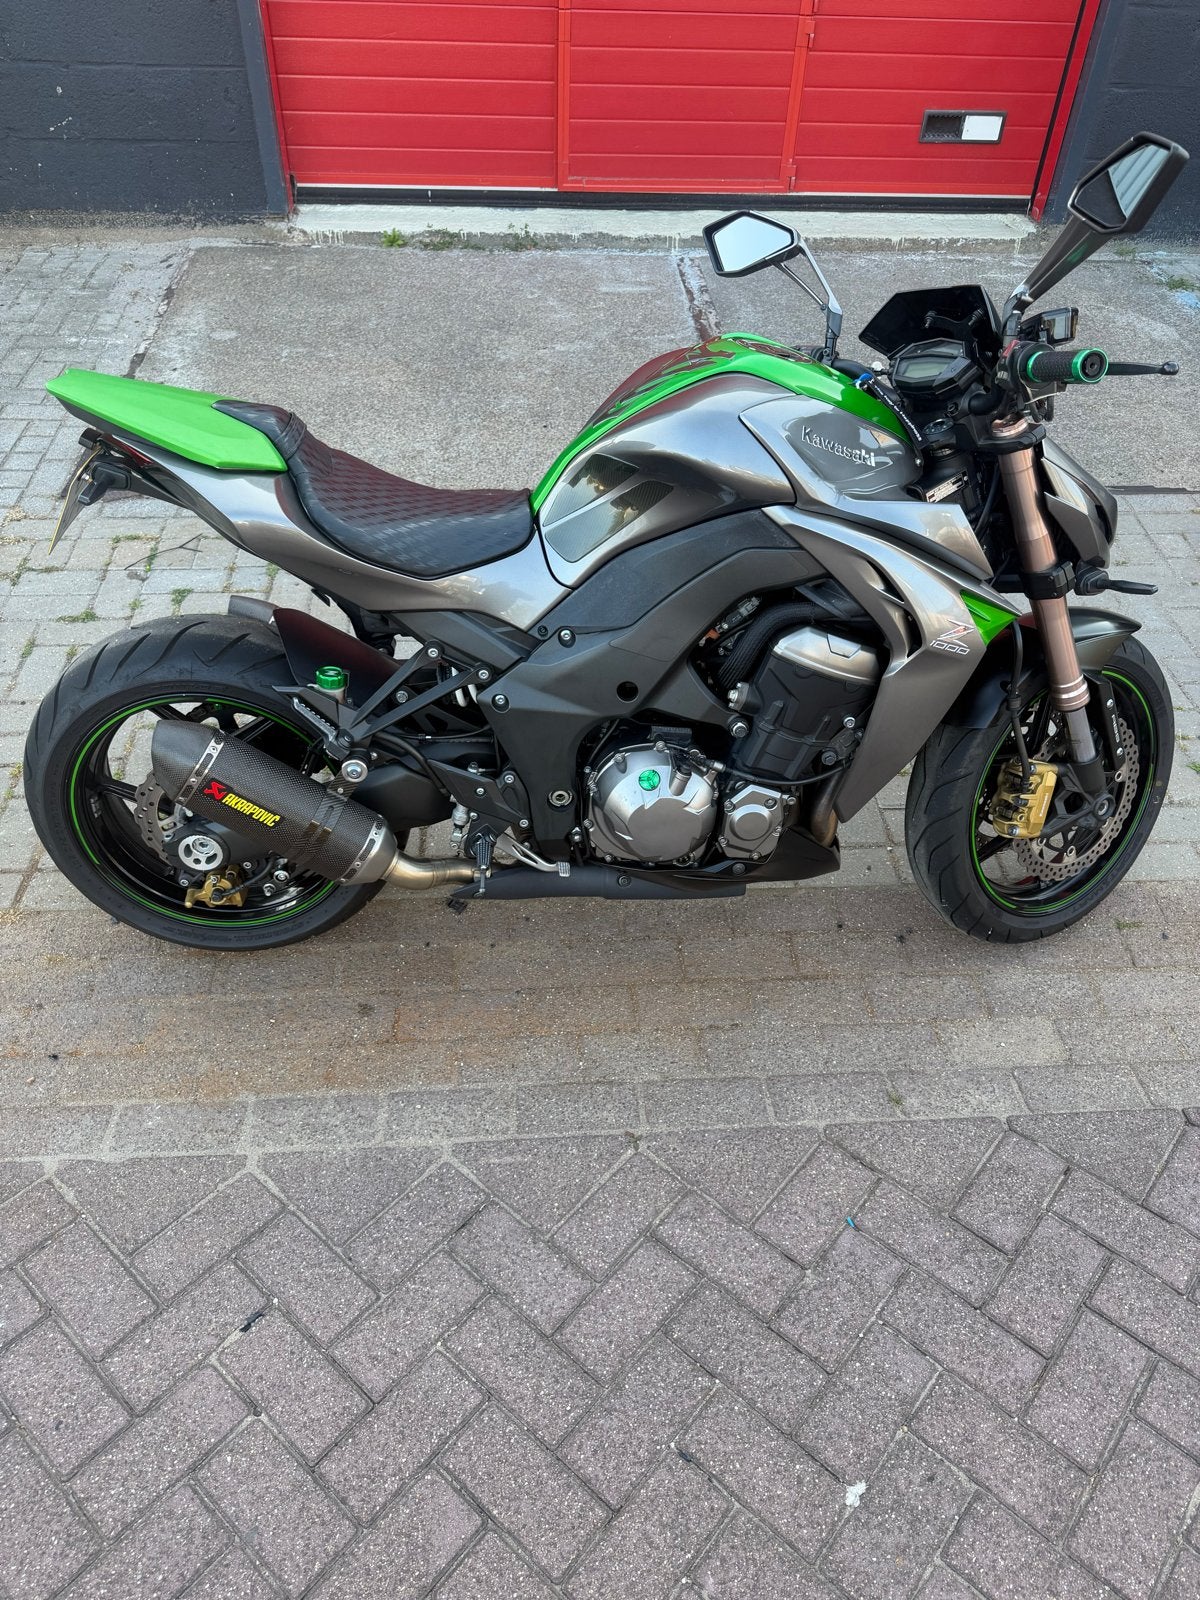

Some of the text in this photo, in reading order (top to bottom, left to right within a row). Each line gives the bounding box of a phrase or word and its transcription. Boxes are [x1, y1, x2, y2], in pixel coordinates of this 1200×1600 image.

[801, 425, 876, 467] Kawasaki
[930, 640, 970, 655] 1000
[937, 618, 974, 648] Z
